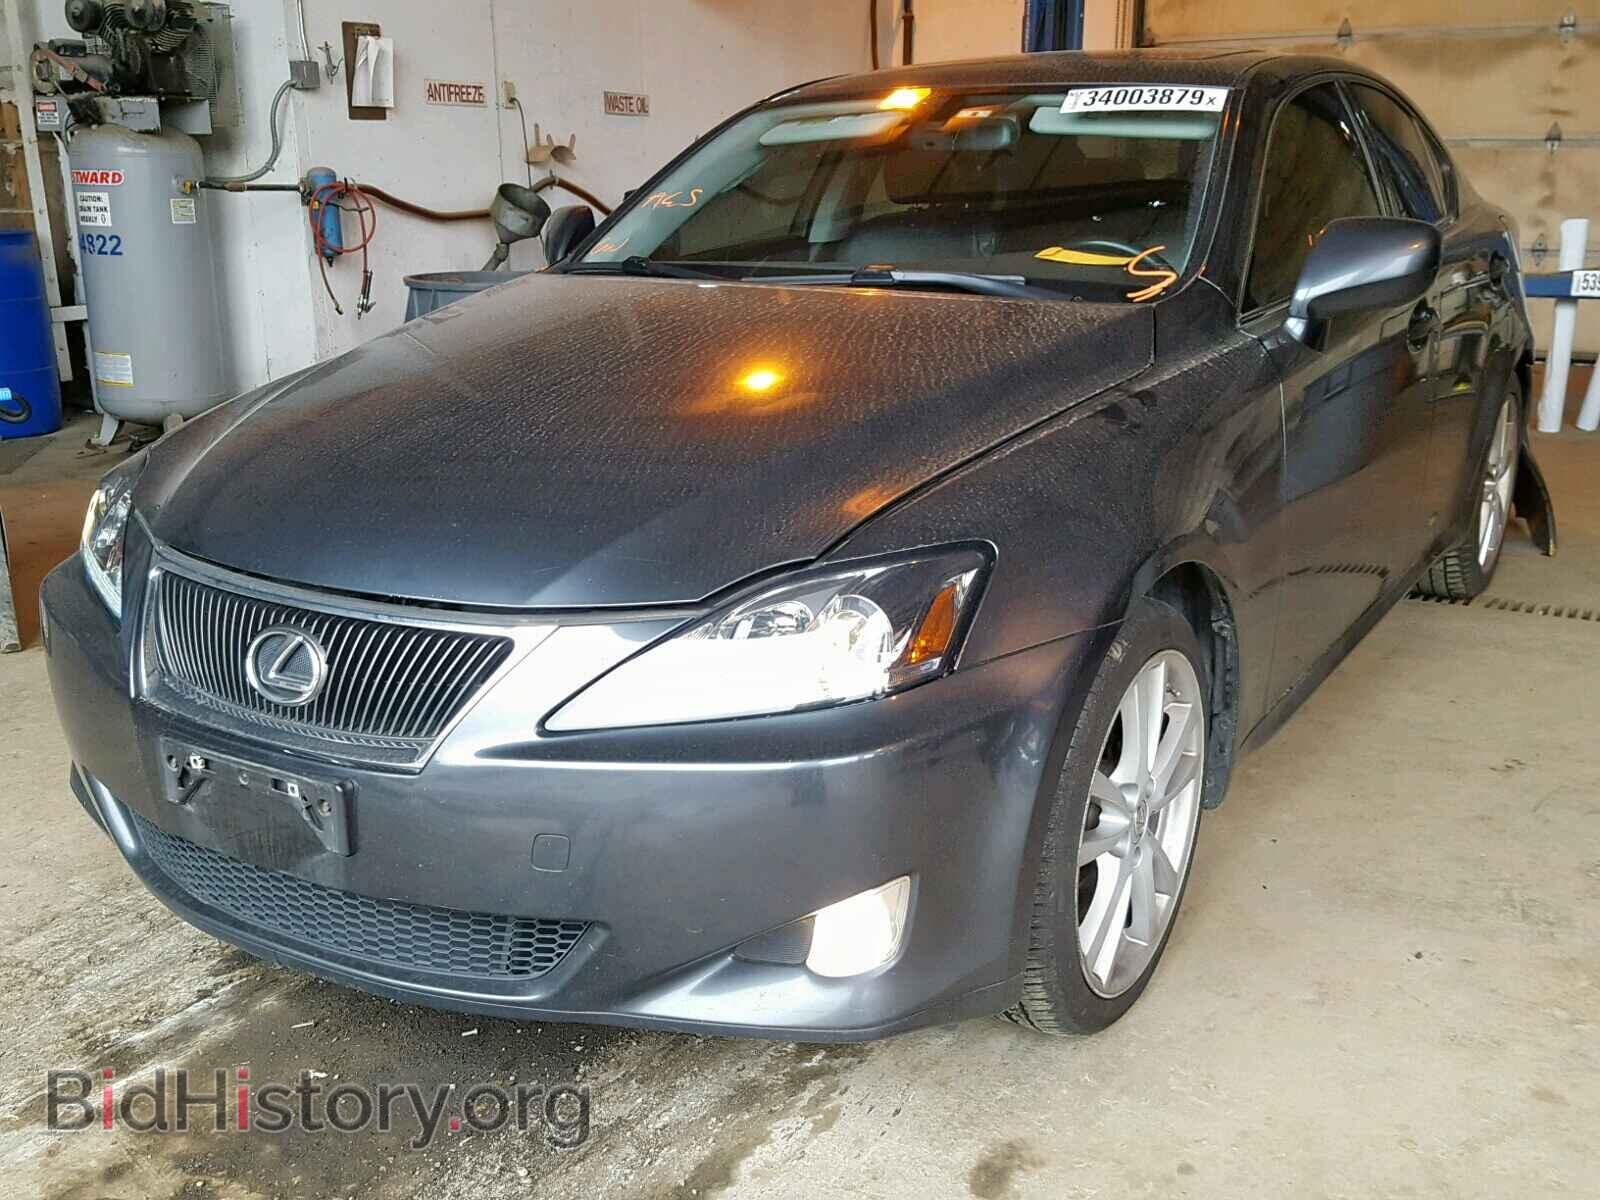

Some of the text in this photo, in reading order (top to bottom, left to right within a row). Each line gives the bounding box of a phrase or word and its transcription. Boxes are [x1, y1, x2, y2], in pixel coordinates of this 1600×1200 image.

[427, 82, 485, 104] ANTIFREEZE
[607, 95, 649, 114] WASTE OIL
